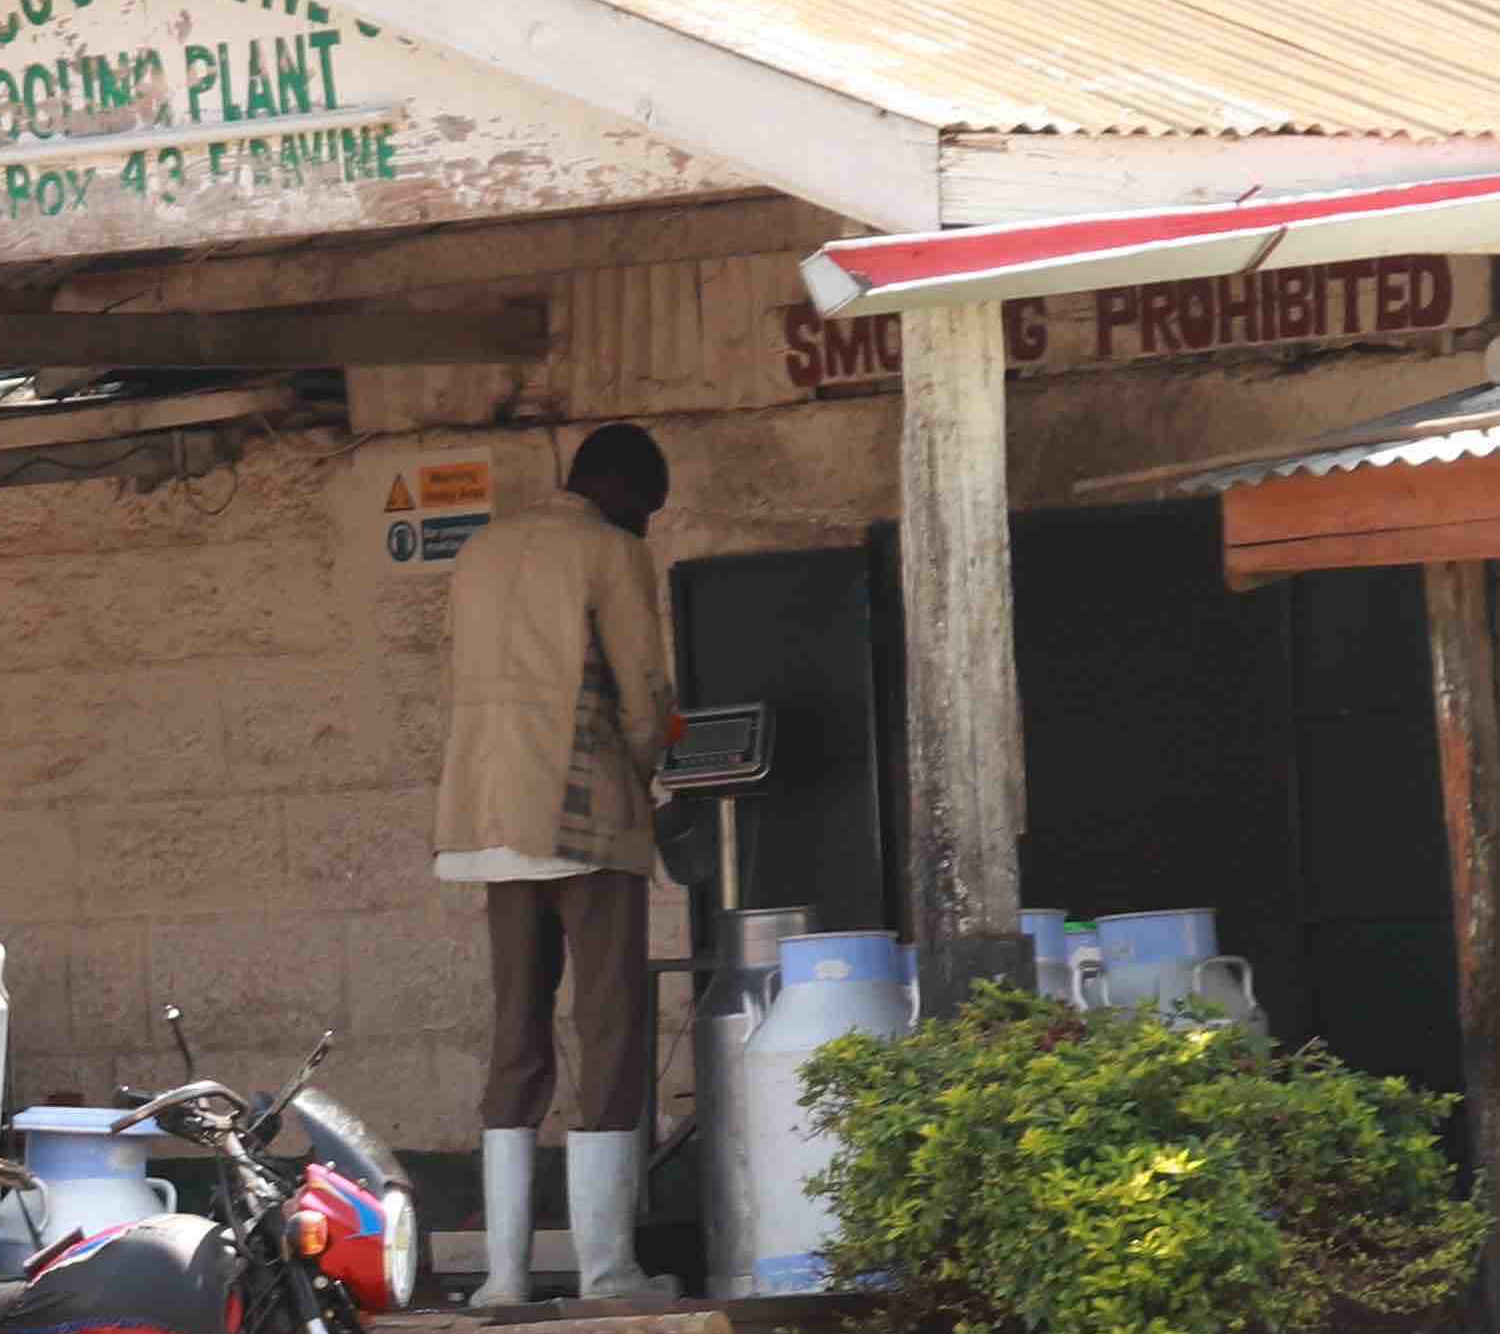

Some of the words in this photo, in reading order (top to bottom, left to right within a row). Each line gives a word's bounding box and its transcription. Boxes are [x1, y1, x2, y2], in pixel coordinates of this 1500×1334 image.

[185, 30, 341, 123] PLANT
[785, 299, 1049, 387] SMOG
[1097, 253, 1452, 357] PROHIBITED
